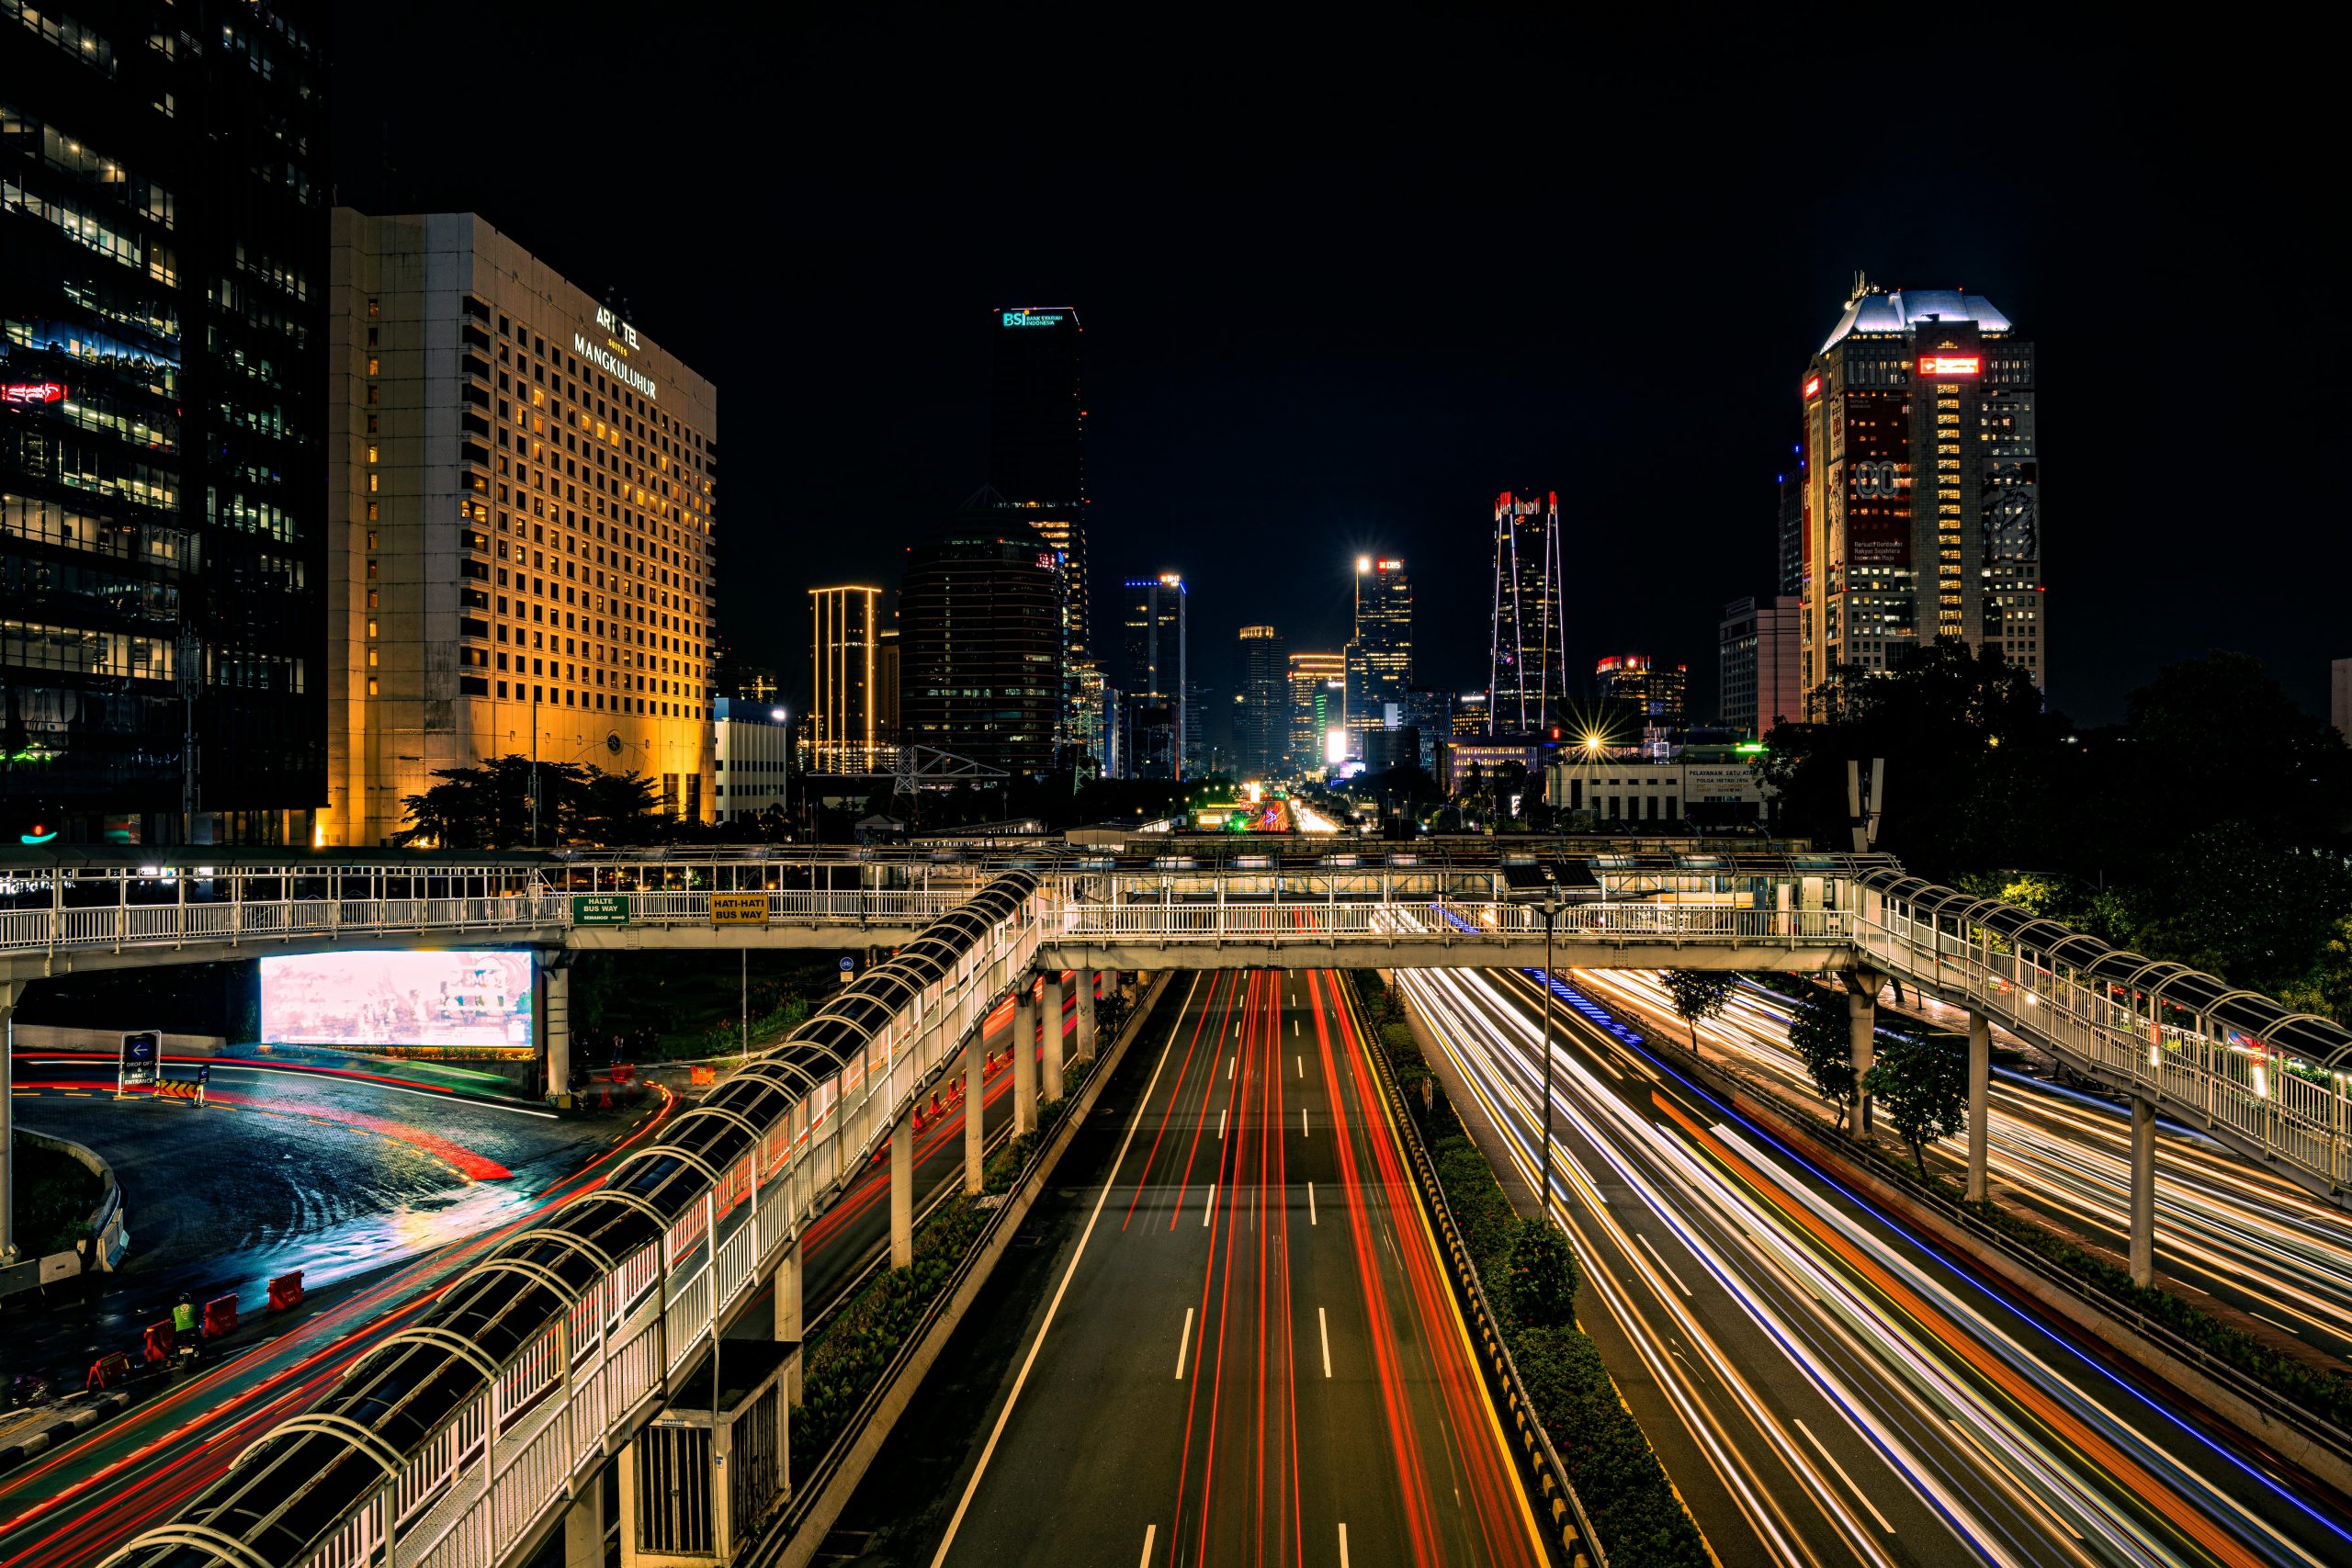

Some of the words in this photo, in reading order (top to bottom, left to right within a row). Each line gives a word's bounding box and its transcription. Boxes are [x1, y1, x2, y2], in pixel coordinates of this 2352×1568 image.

[1003, 312, 1026, 326] BSI
[607, 338, 628, 357] SUITES
[574, 333, 656, 400] MANGKULUHUR
[1856, 460, 1900, 500] 80
[1385, 561, 1401, 570] DBS
[714, 899, 764, 908] HATI-HATI
